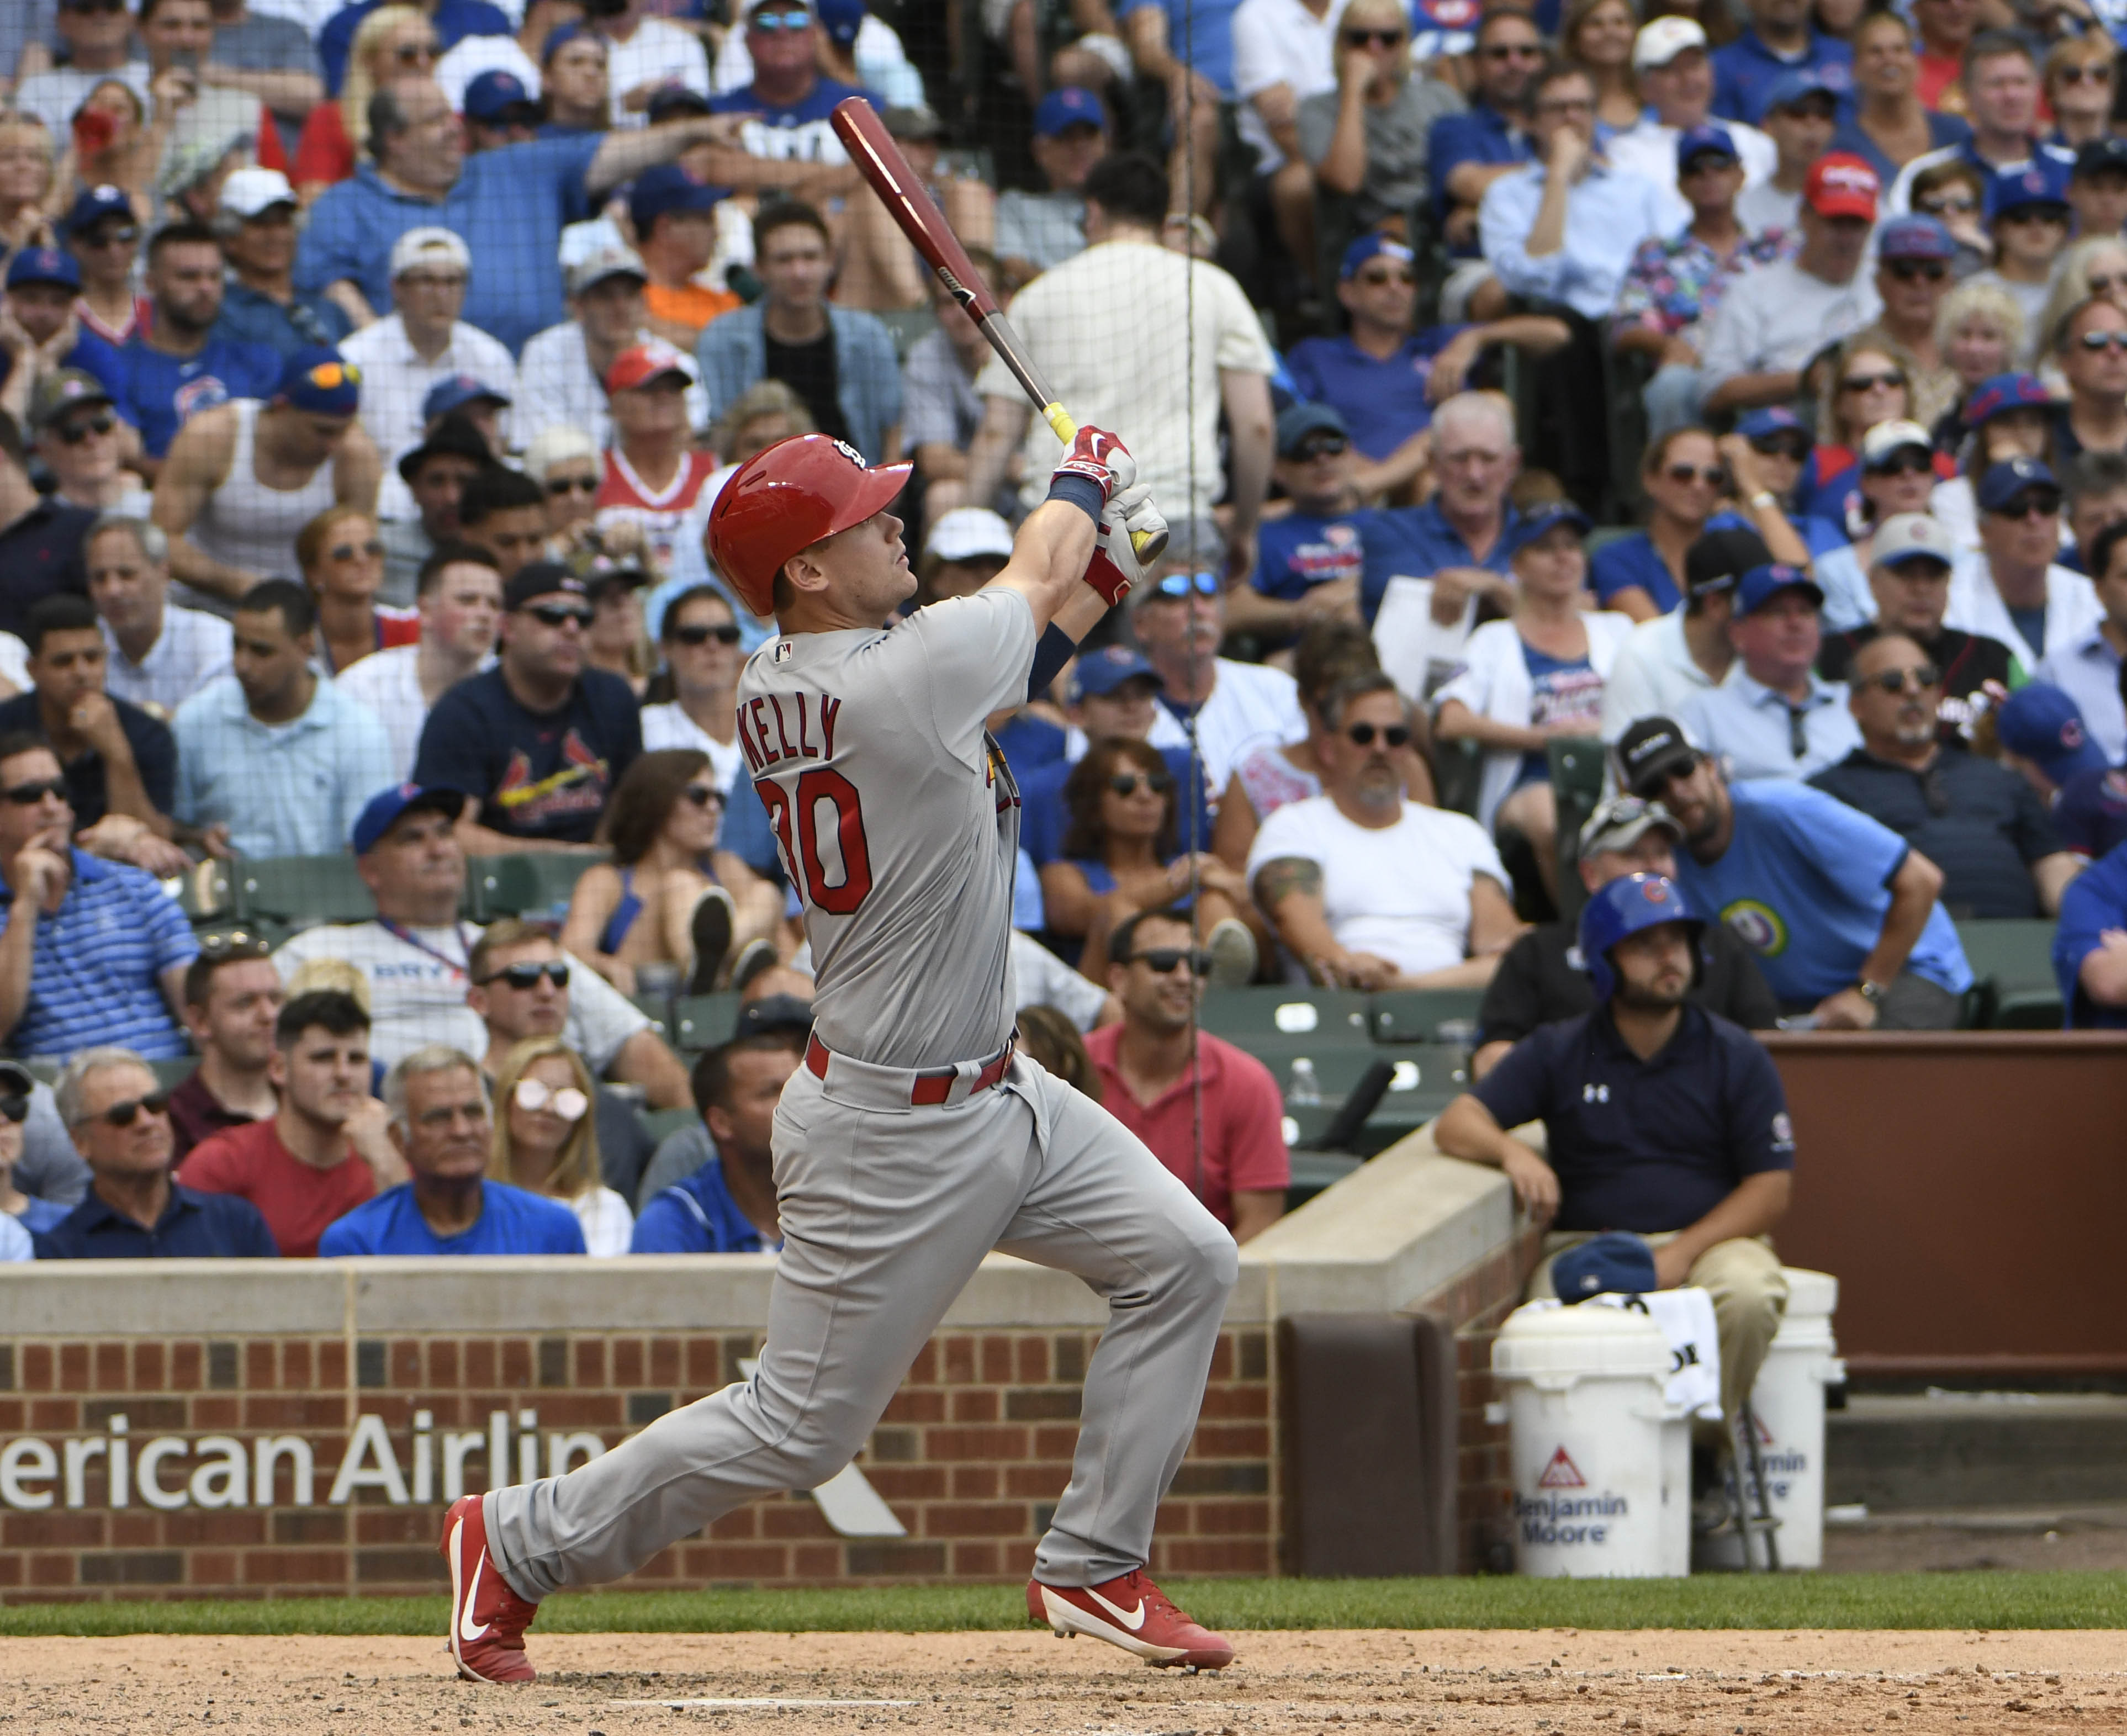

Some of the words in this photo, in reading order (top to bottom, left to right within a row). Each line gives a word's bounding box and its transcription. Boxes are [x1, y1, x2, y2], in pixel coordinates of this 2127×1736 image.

[736, 691, 842, 773] KELLY
[0, 1413, 314, 1509] erican
[329, 1409, 635, 1504] Airlin
